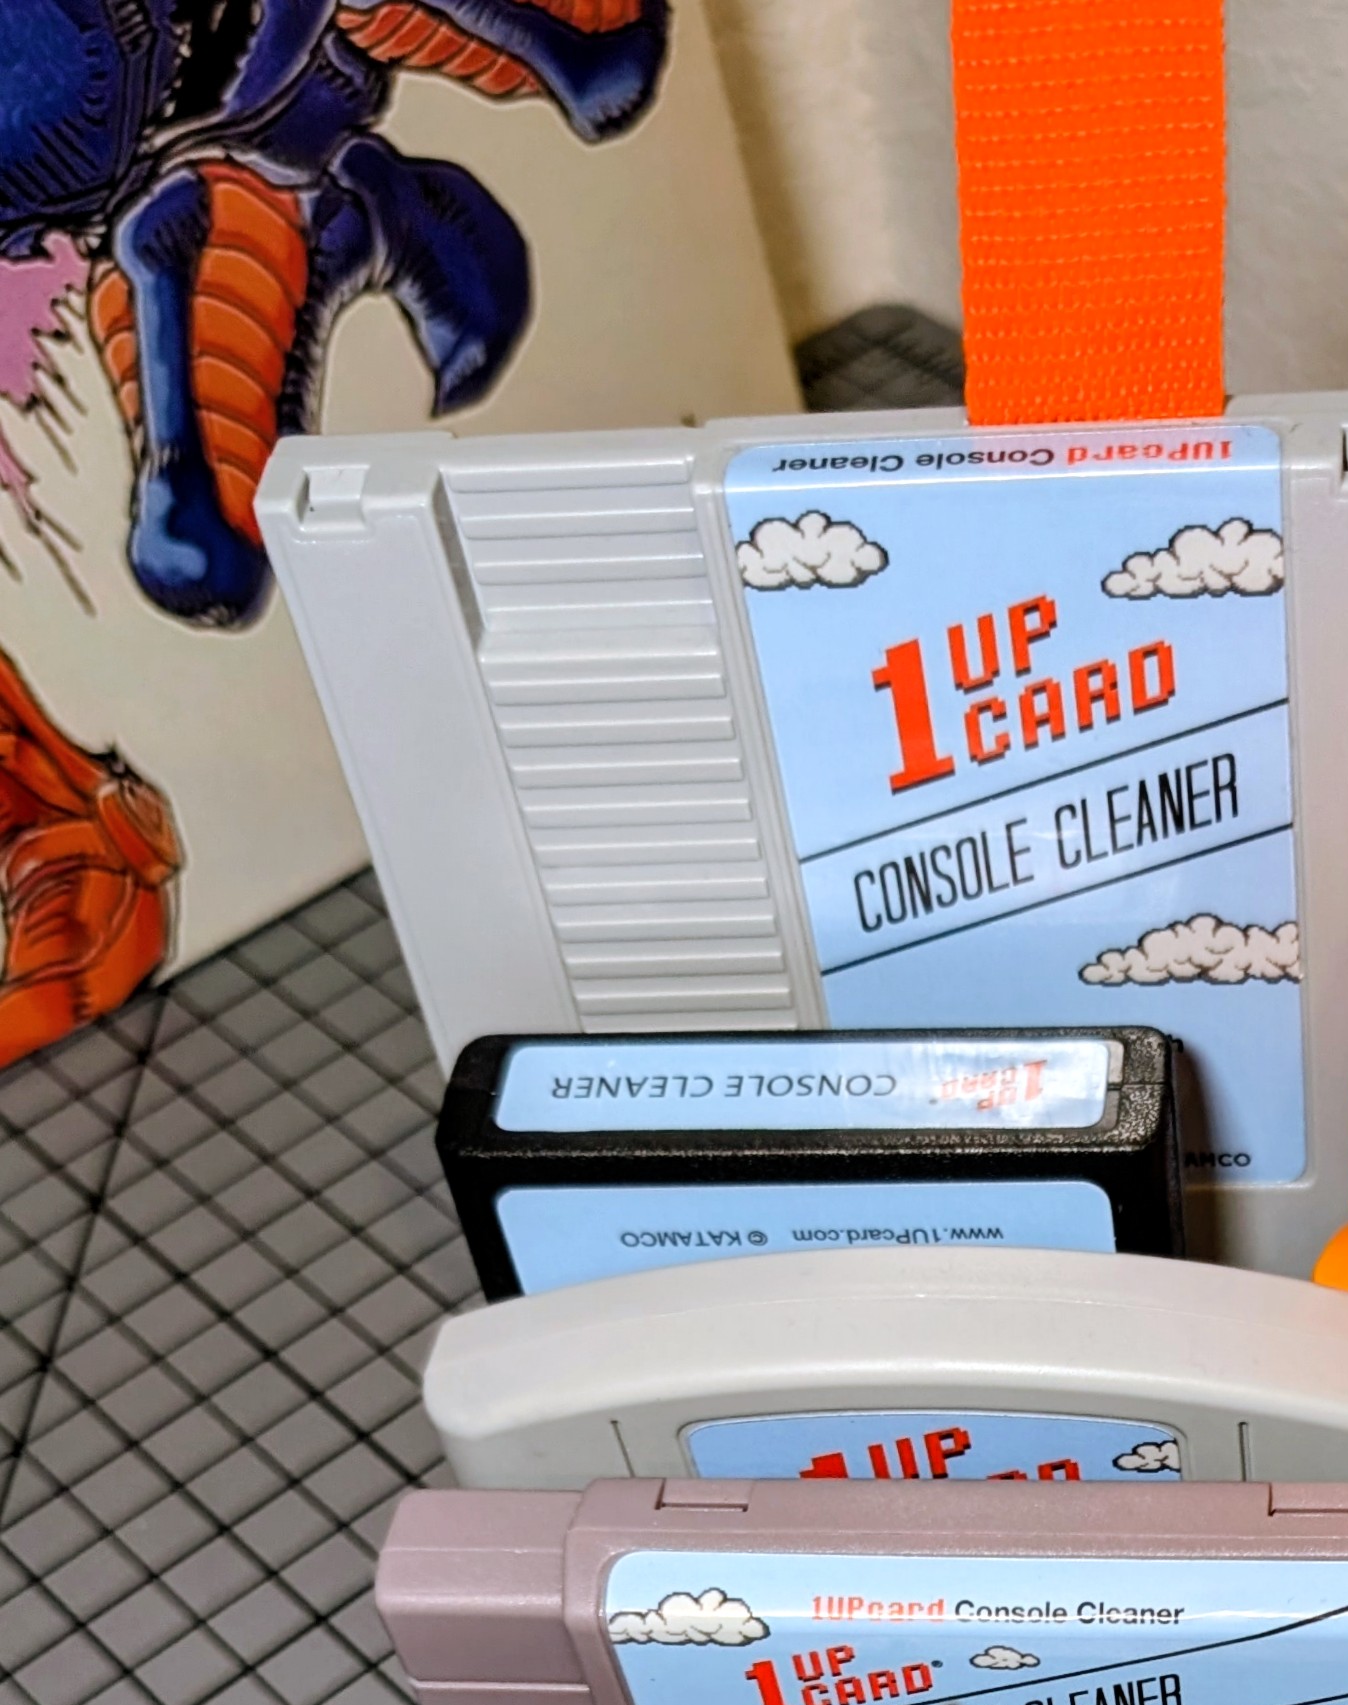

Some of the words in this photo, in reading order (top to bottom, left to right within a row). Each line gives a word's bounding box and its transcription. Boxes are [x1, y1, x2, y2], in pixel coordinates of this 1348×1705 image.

[772, 453, 905, 474] Cleaner
[914, 447, 1055, 471] Console
[1066, 438, 1233, 468] 1UPcard
[947, 595, 1058, 695] UP
[963, 639, 1177, 765] CARD
[852, 817, 1035, 935] CONSOLE
[1053, 751, 1240, 872] CLEANER
[551, 1073, 714, 1100] CLEANER
[724, 1073, 898, 1099] CONSOLE
[1183, 1151, 1253, 1168] AMCO
[619, 1230, 741, 1248] KATAMCO
[791, 1225, 1005, 1246] www.1UPcard.com
[811, 1595, 946, 1623] 1UPcard
[954, 1599, 1068, 1624] Console
[1076, 1601, 1186, 1625] Cleaner
[791, 1644, 856, 1683] UP
